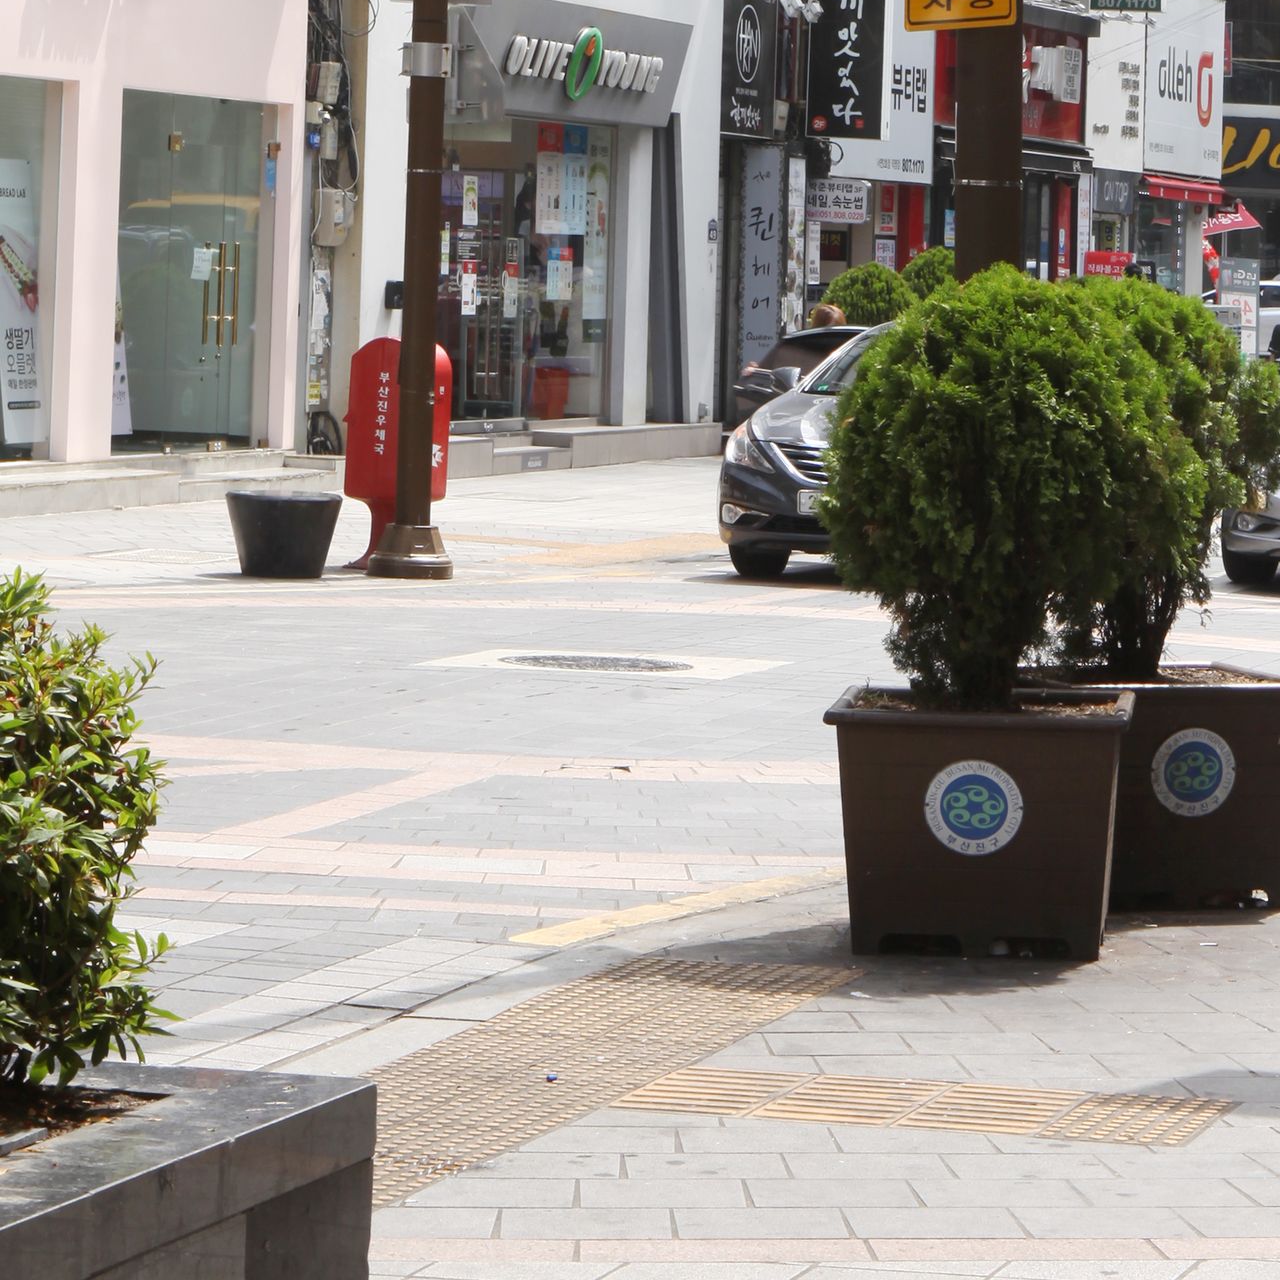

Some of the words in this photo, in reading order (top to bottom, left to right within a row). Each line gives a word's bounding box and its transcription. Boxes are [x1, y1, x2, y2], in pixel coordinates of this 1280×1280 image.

[505, 33, 574, 82] OLIVE
[596, 48, 664, 94] YOUNG
[891, 64, 928, 115] 뷰티랩
[1087, 263, 1126, 274] 직화불고
[4, 328, 35, 350] 생딸기
[373, 371, 391, 456] 부산진우체국
[977, 763, 1022, 815] METROPOLITAN
